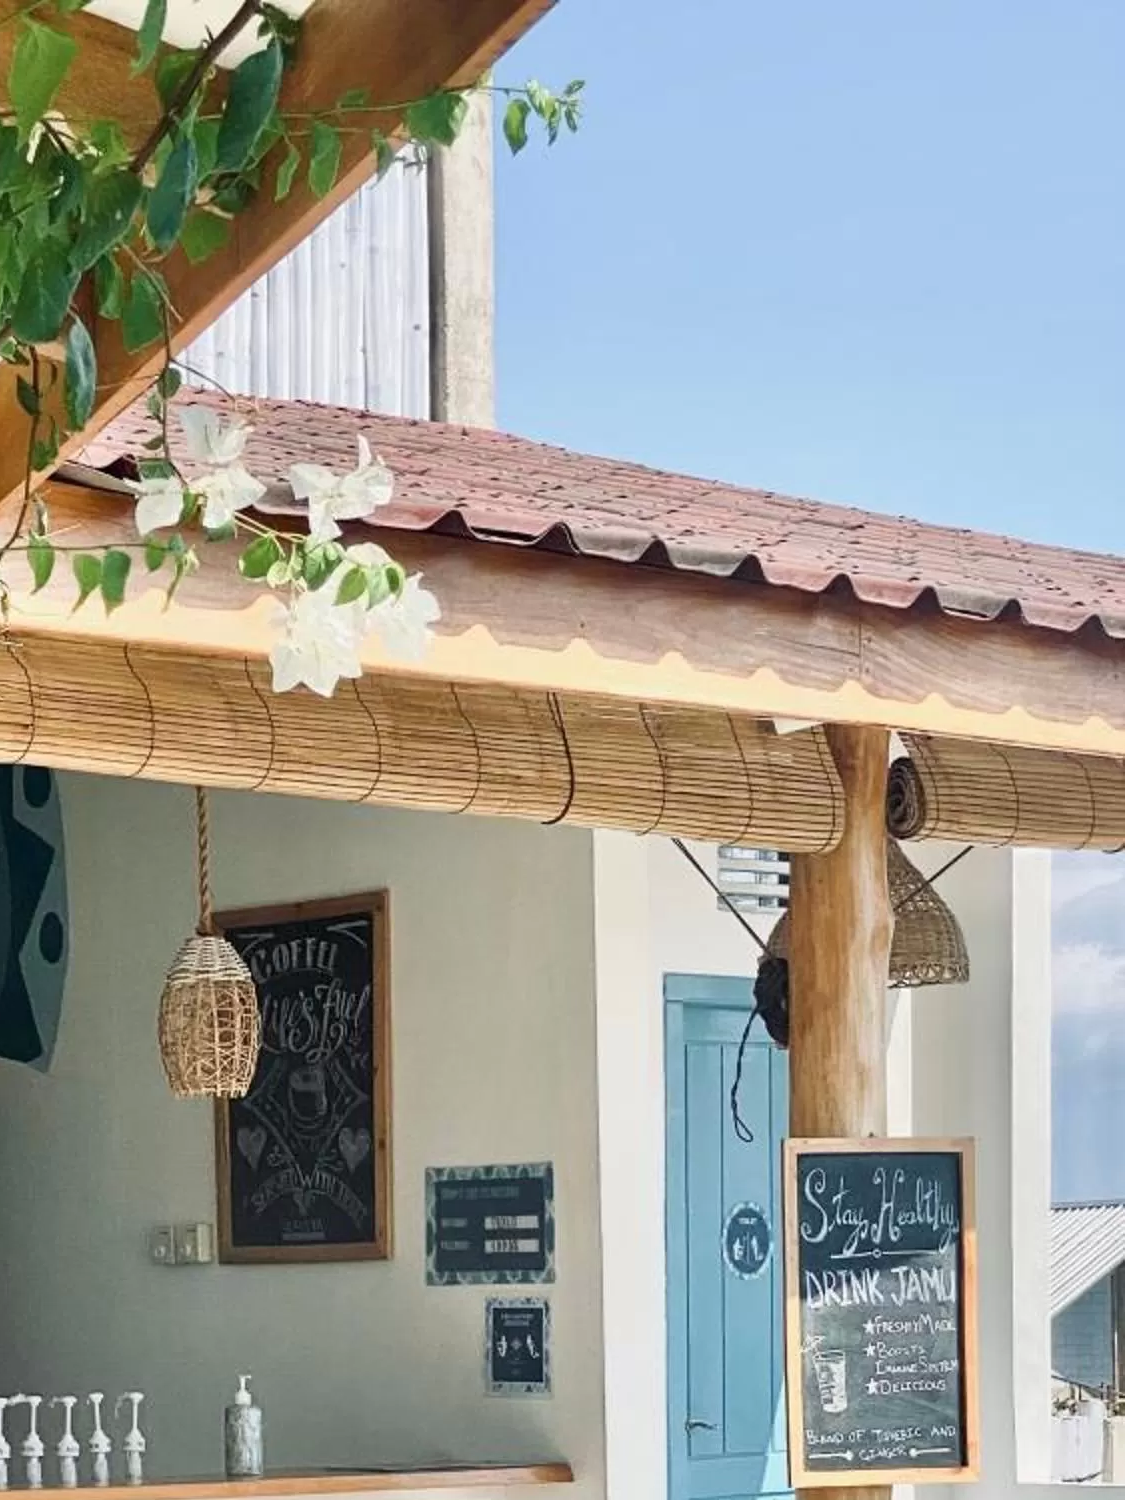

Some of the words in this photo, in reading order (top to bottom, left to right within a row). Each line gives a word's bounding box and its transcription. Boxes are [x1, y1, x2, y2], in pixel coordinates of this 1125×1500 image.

[801, 1168, 869, 1256] Stay
[871, 1168, 959, 1253] Healthy
[805, 1268, 884, 1308] DRINK
[891, 1266, 956, 1307] JAMU
